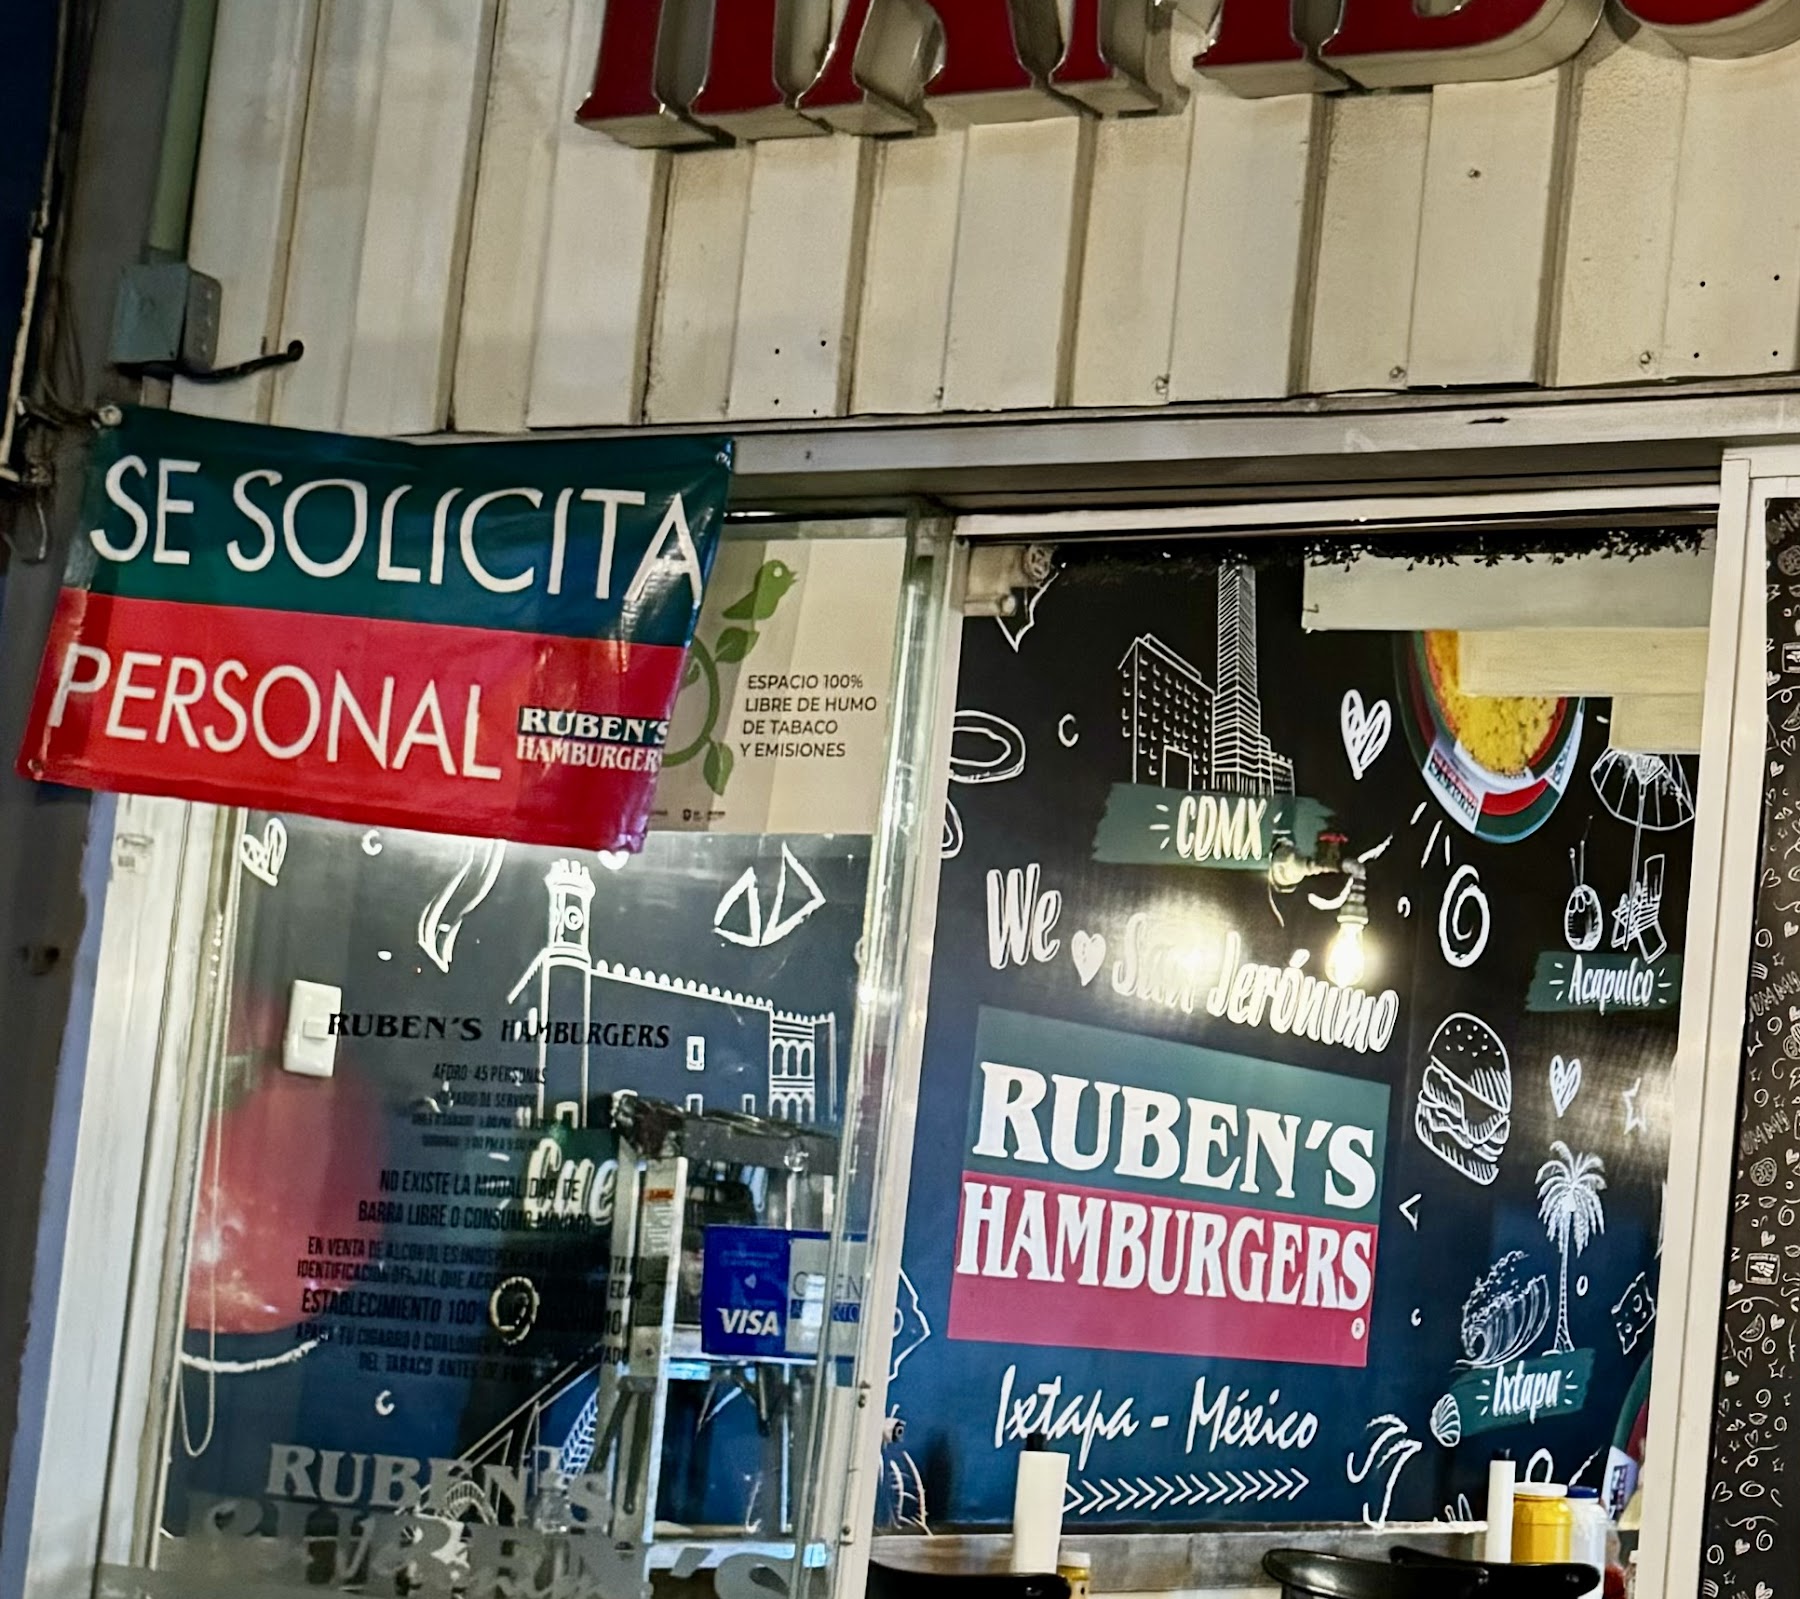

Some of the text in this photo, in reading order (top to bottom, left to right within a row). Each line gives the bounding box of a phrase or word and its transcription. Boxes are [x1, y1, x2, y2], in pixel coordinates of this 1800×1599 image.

[90, 455, 704, 606] SE SOLICITA
[747, 674, 863, 689] ESPACIO 100%
[48, 642, 502, 780] PERSONAL
[745, 696, 877, 712] LIBRE DE HUMO
[520, 706, 669, 744] RUBEN'S
[743, 720, 838, 735] DE TABACO
[740, 743, 846, 757] Y EMISIONES
[1176, 795, 1268, 862] CDMX
[986, 863, 1063, 969] We
[1207, 930, 1400, 1054] Jerónimo
[1568, 954, 1655, 1017] Acapulco
[328, 1013, 671, 1049] RUBEN'S HAMBURGERS
[474, 1065, 490, 1081] 45
[972, 1061, 1377, 1209] RUBEN'S
[379, 1170, 401, 1191] NO
[402, 1172, 450, 1195] EXISTE
[453, 1173, 470, 1196] LA
[358, 1201, 403, 1223] BARRA
[407, 1204, 446, 1226] LIBRE
[451, 1206, 461, 1228] O
[956, 1181, 1372, 1312] HAMBURGERS
[302, 1288, 443, 1323] ESTABLECIMIENTO
[718, 1308, 780, 1336] VISA
[1492, 1360, 1562, 1424] Ixtapa
[994, 1364, 1140, 1472] Ixtapa
[1185, 1376, 1319, 1454] México
[267, 1443, 613, 1527] RUBEN'S
